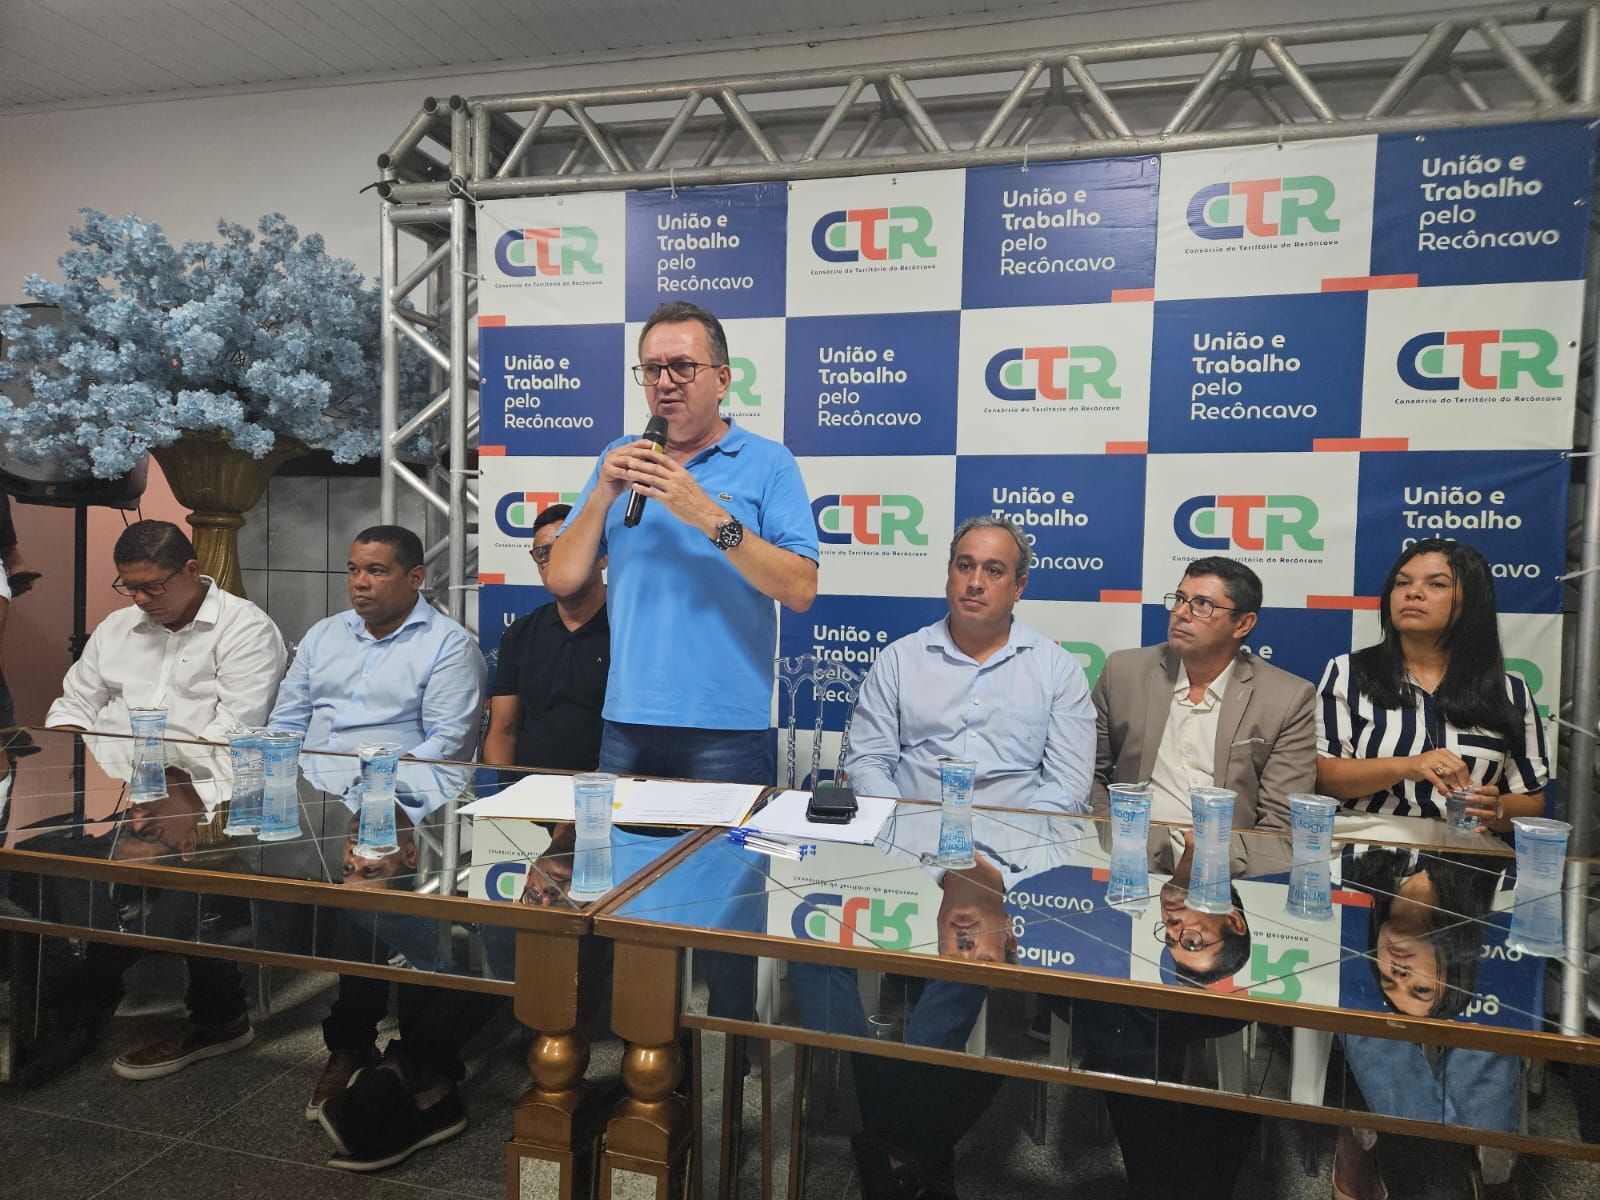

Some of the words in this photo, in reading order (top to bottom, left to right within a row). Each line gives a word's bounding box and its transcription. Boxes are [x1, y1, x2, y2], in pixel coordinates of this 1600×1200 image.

[1422, 156, 1500, 178] União
[1509, 156, 1525, 171] e
[1003, 187, 1067, 208] União
[1074, 189, 1086, 202] e
[1420, 178, 1542, 202] Trabalho
[1186, 175, 1341, 240] CTR
[1419, 204, 1476, 230] pelo
[657, 213, 710, 230] União
[716, 214, 728, 227] e
[1002, 209, 1100, 230] Trabalho
[657, 232, 740, 250] Trabalho
[811, 205, 937, 263] CTR
[1001, 232, 1047, 256] pelo
[1418, 227, 1560, 251] Recôncavo
[495, 226, 603, 277] CTR
[658, 255, 696, 275] pelo
[1000, 254, 1116, 275] Recôncavo
[657, 275, 754, 292] Recôncavo
[1193, 332, 1263, 351] União
[1271, 334, 1286, 348] e
[504, 354, 554, 370] União
[559, 357, 570, 369] e
[819, 346, 877, 364] União
[883, 349, 895, 362] e
[1192, 354, 1301, 374] Trabalho
[1397, 329, 1563, 390] CTR
[504, 374, 581, 390] Trabalho
[818, 366, 907, 385] Trabalho
[985, 345, 1121, 401] CTR
[818, 389, 859, 409] pelo
[1191, 378, 1242, 401] pelo
[504, 393, 540, 412] pelo
[1191, 402, 1318, 421] Recôncavo
[504, 413, 593, 428] Recôncavo
[818, 410, 922, 427] Recôncavo
[992, 487, 1056, 504] União
[1061, 489, 1075, 504] e
[1403, 486, 1473, 505] União
[1489, 489, 1505, 505] e
[495, 491, 581, 538] CT
[815, 494, 928, 546] CTR
[991, 508, 1088, 526] Trabalho
[1173, 495, 1325, 550] CTR
[1402, 510, 1522, 529] Trabalho
[1029, 552, 1104, 570] ôncavo
[813, 624, 870, 642] União
[876, 630, 888, 642] e
[812, 645, 881, 663] Trabal
